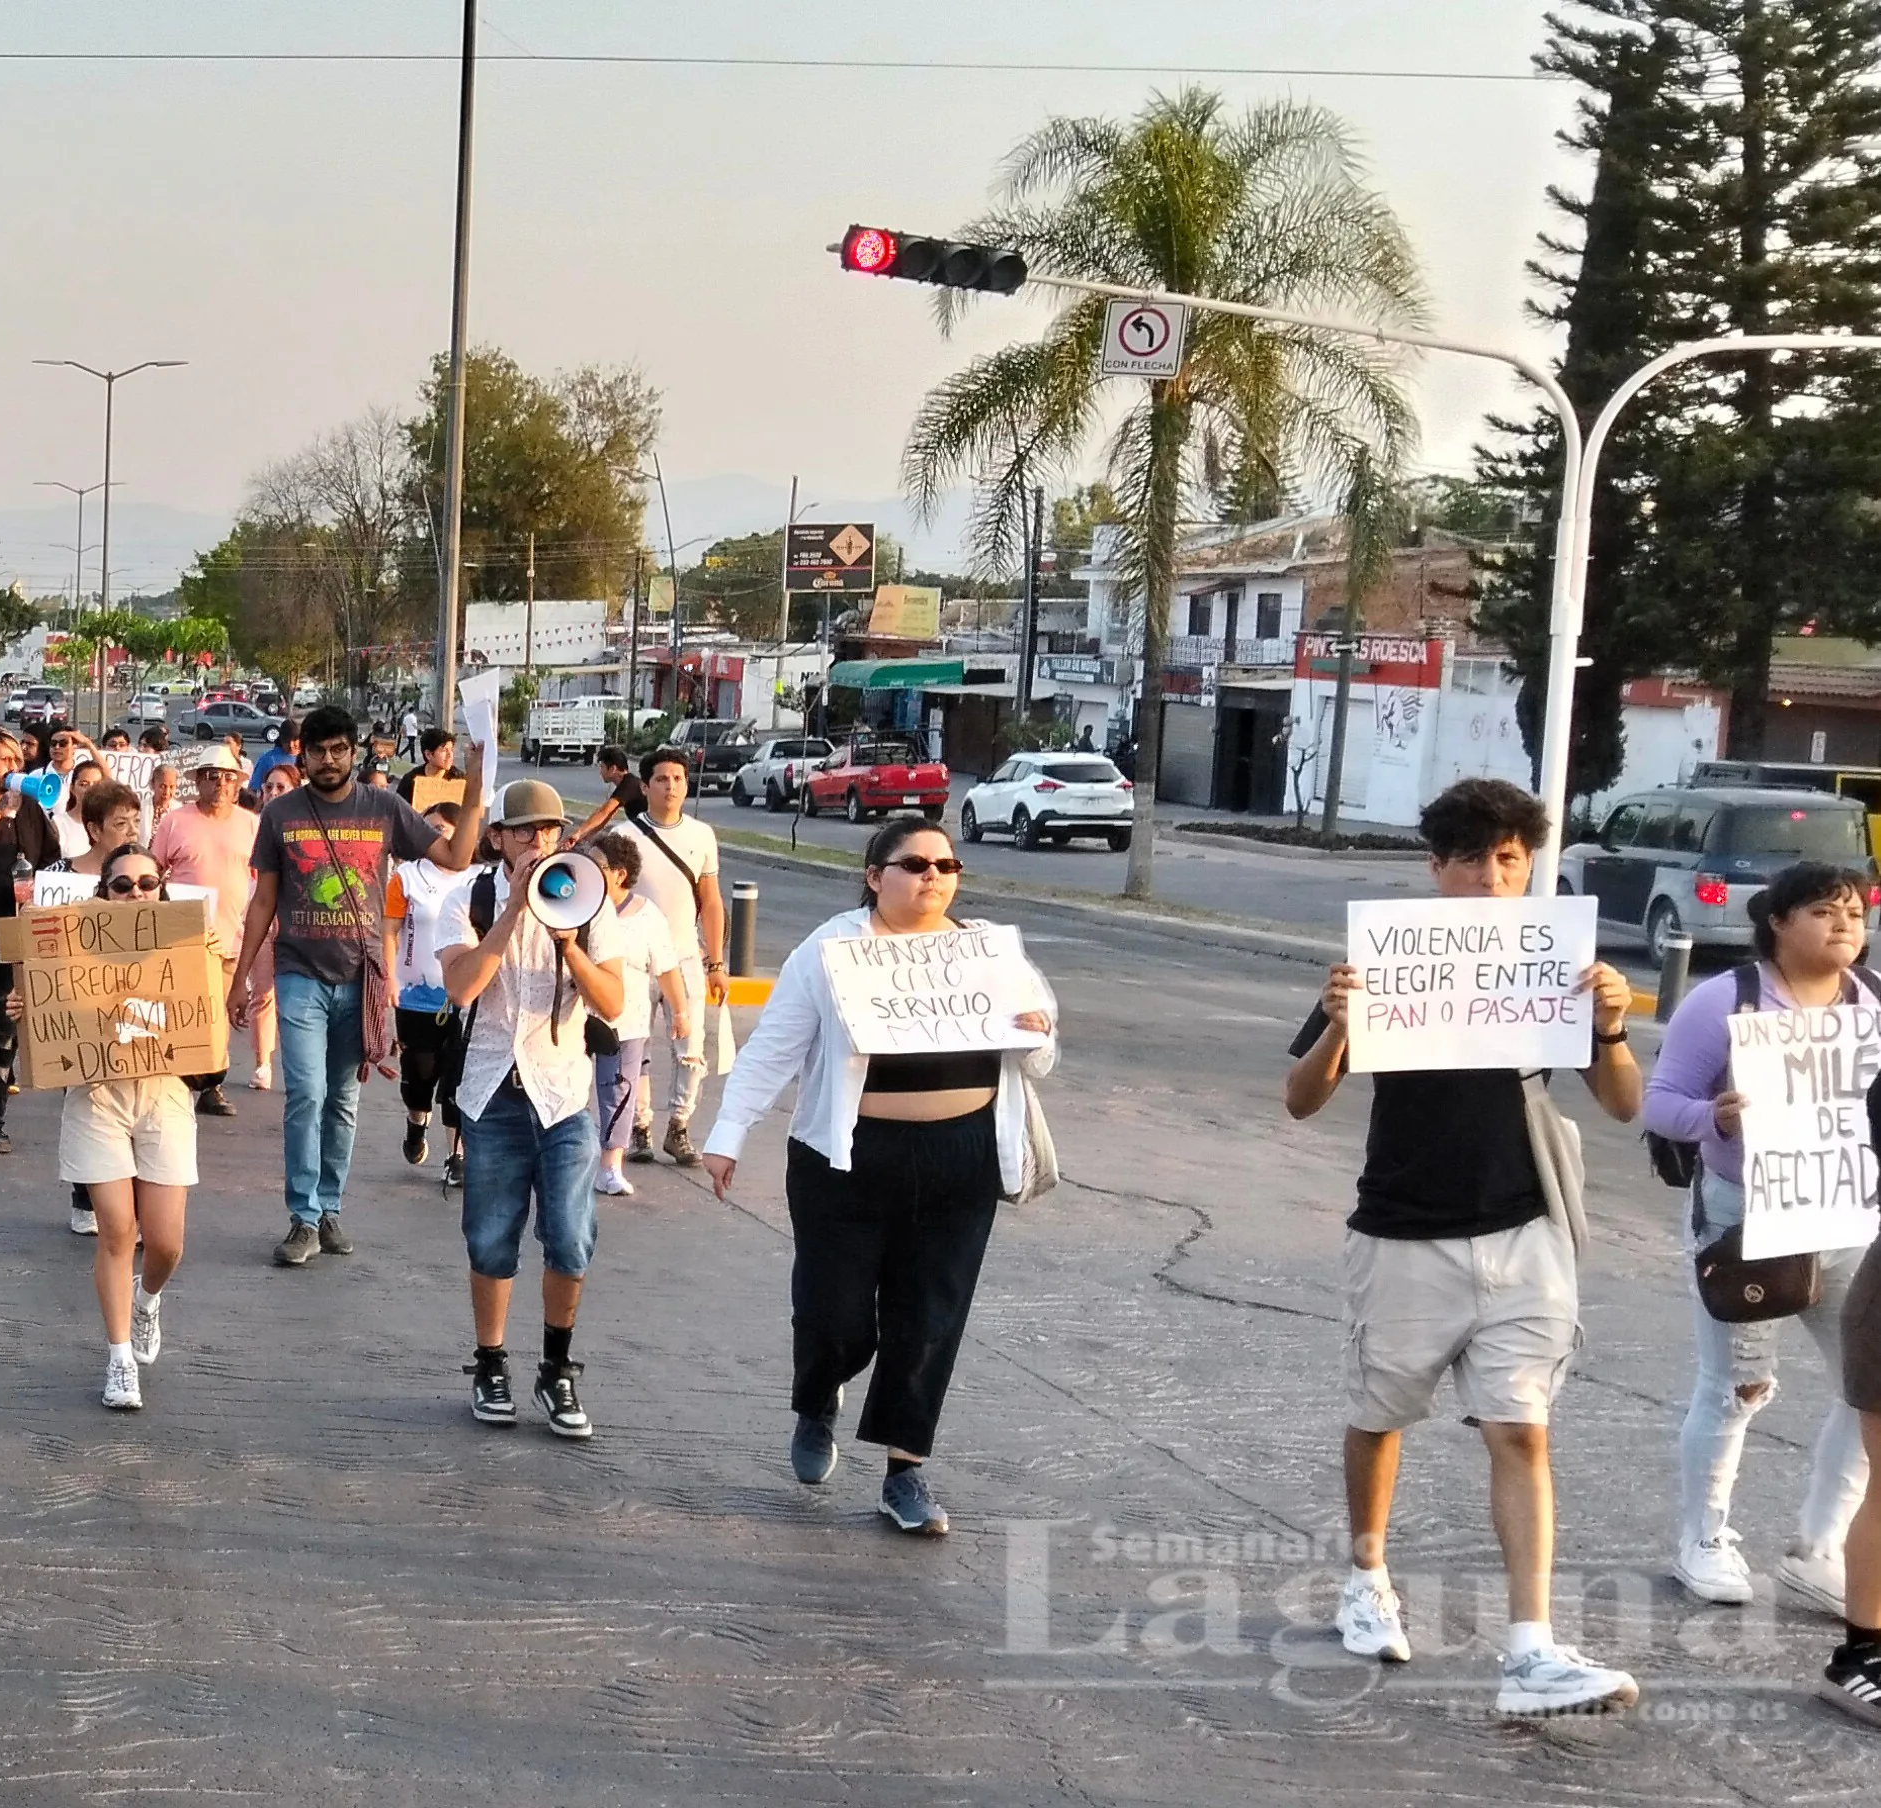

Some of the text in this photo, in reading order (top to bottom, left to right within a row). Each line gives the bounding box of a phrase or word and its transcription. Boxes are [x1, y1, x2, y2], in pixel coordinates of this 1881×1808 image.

[1105, 360, 1174, 371] CON FLECHA
[812, 577, 844, 588] Corona
[63, 908, 173, 957] POR EL
[839, 929, 999, 967] TRANSPORTE
[1368, 925, 1555, 957] VIOLENCIA ES
[28, 958, 175, 1008] DERECHO A
[1365, 960, 1571, 996] ELEGIR ENTRE
[30, 994, 220, 1044] UNA MOVILIDAD
[870, 991, 992, 1021] SERVICIO
[1368, 1001, 1428, 1033] PAN
[1467, 996, 1579, 1027] PASAJE
[1734, 1018, 1773, 1048] UN
[76, 1034, 169, 1082] DIGNA
[1816, 1105, 1857, 1142] DE
